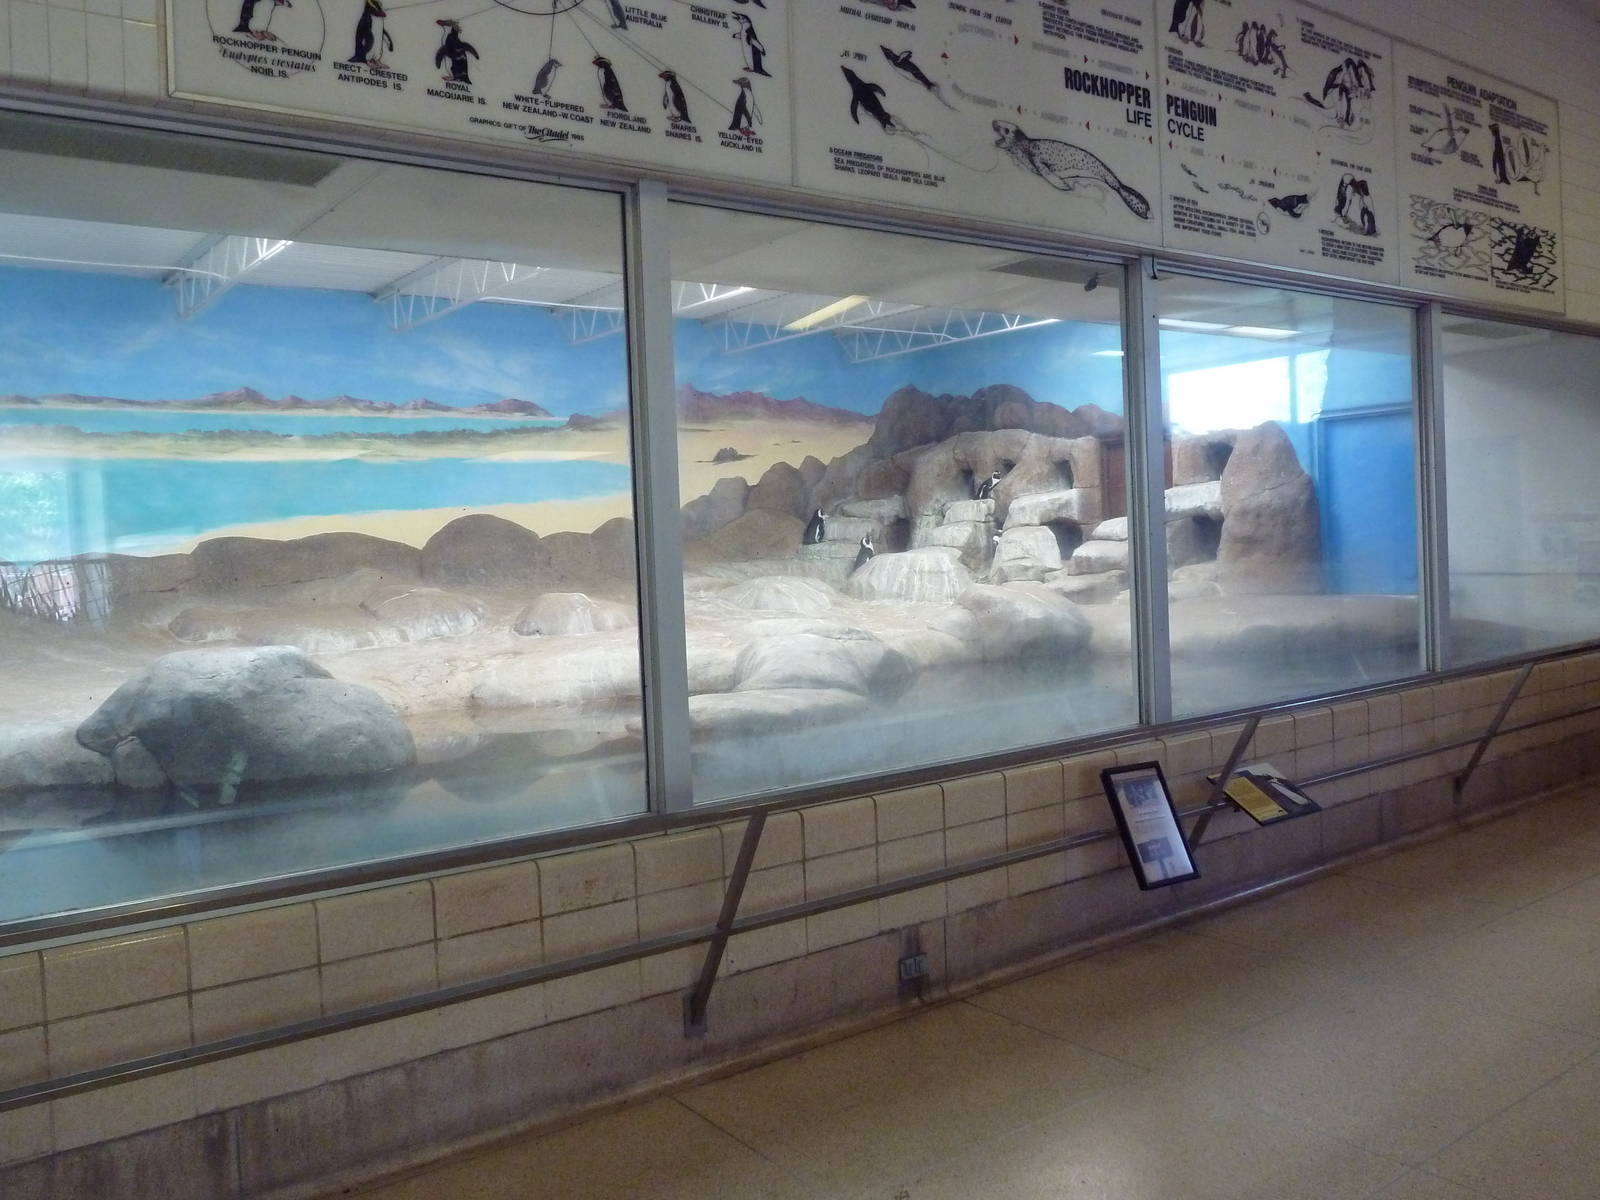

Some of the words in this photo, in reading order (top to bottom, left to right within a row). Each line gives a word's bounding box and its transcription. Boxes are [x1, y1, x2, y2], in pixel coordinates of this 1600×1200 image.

[625, 6, 649, 17] LITTLE
[650, 12, 667, 22] BLUE
[625, 14, 663, 29] AUSTRALIA
[212, 35, 278, 53] ROCKHOPPER
[281, 47, 321, 61] PENGUIN
[250, 65, 274, 77] NOIR
[333, 62, 362, 73] ERECT
[369, 68, 408, 82] CRESTED
[337, 73, 388, 89] ANTIPODES
[445, 82, 471, 93] ROYAL
[1064, 67, 1151, 109] ROCKHOPPER
[427, 88, 474, 104] MACQUARIE
[514, 94, 585, 113] WHITE-FLIPPERED
[502, 102, 520, 111] NEW
[1166, 94, 1217, 127] PENGUIN
[503, 122, 517, 130] GIFT
[600, 118, 617, 128] NEW
[619, 122, 651, 134] ZEALAND
[1126, 108, 1153, 128] LIFE
[718, 131, 763, 145] YELLOW-EYED
[1167, 118, 1205, 142] CYCLE
[720, 140, 754, 152] AUCKLAND
